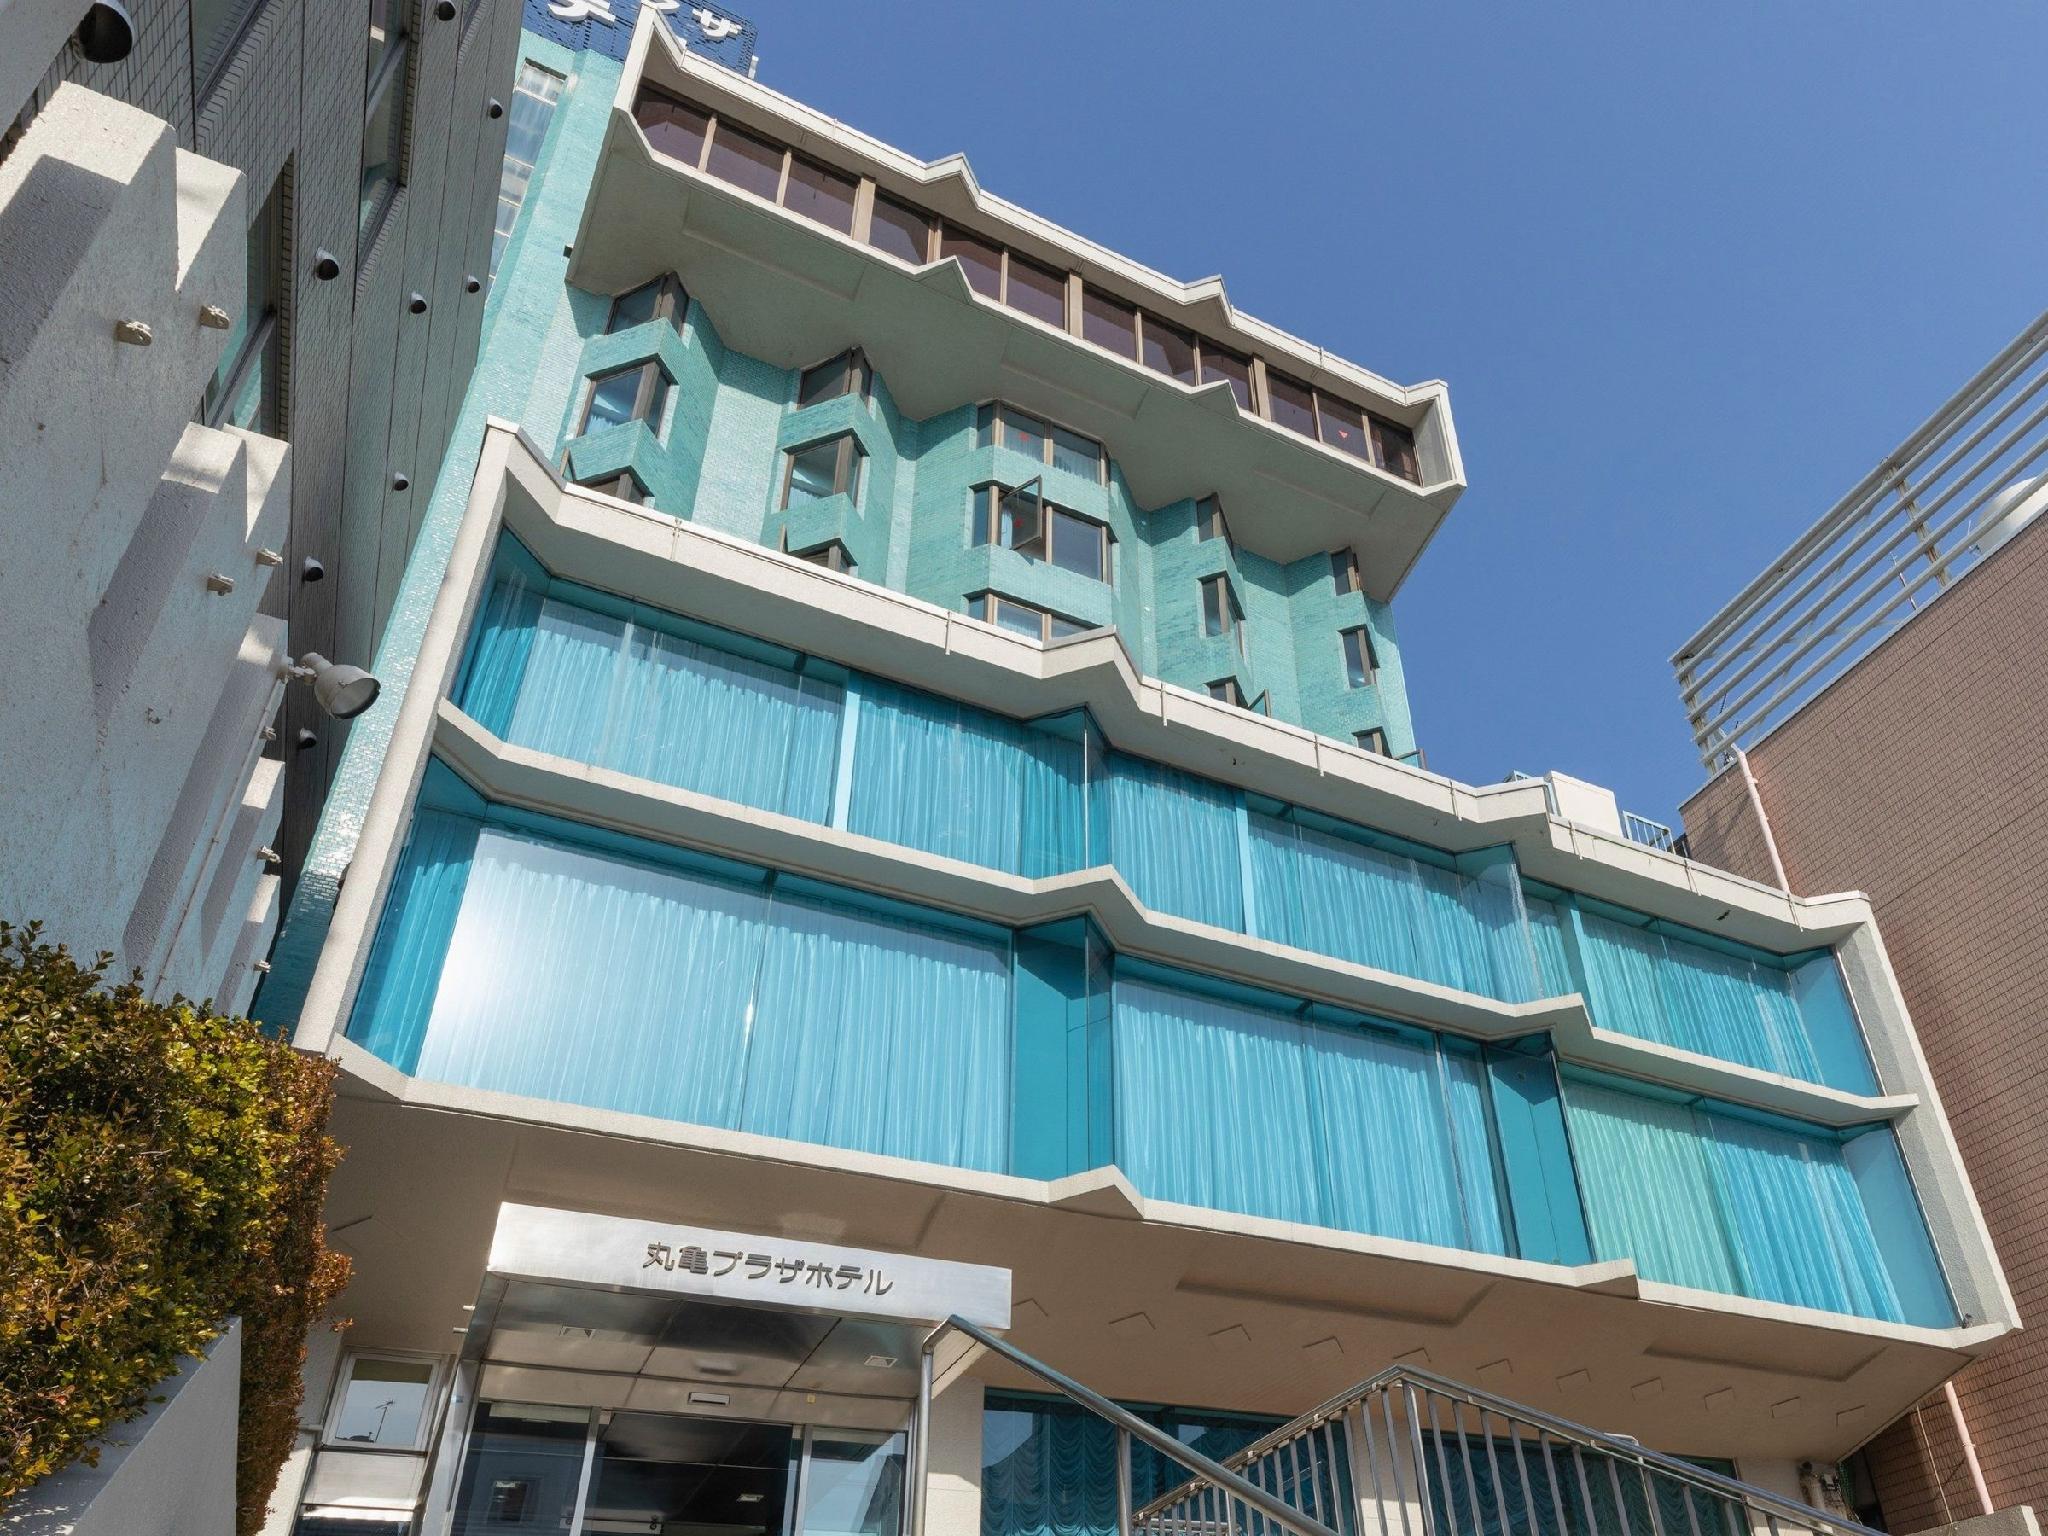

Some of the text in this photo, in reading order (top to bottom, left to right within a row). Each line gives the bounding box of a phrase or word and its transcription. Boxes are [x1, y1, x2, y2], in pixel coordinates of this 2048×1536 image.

[642, 1241, 894, 1296] 丸亀プラザホテル
